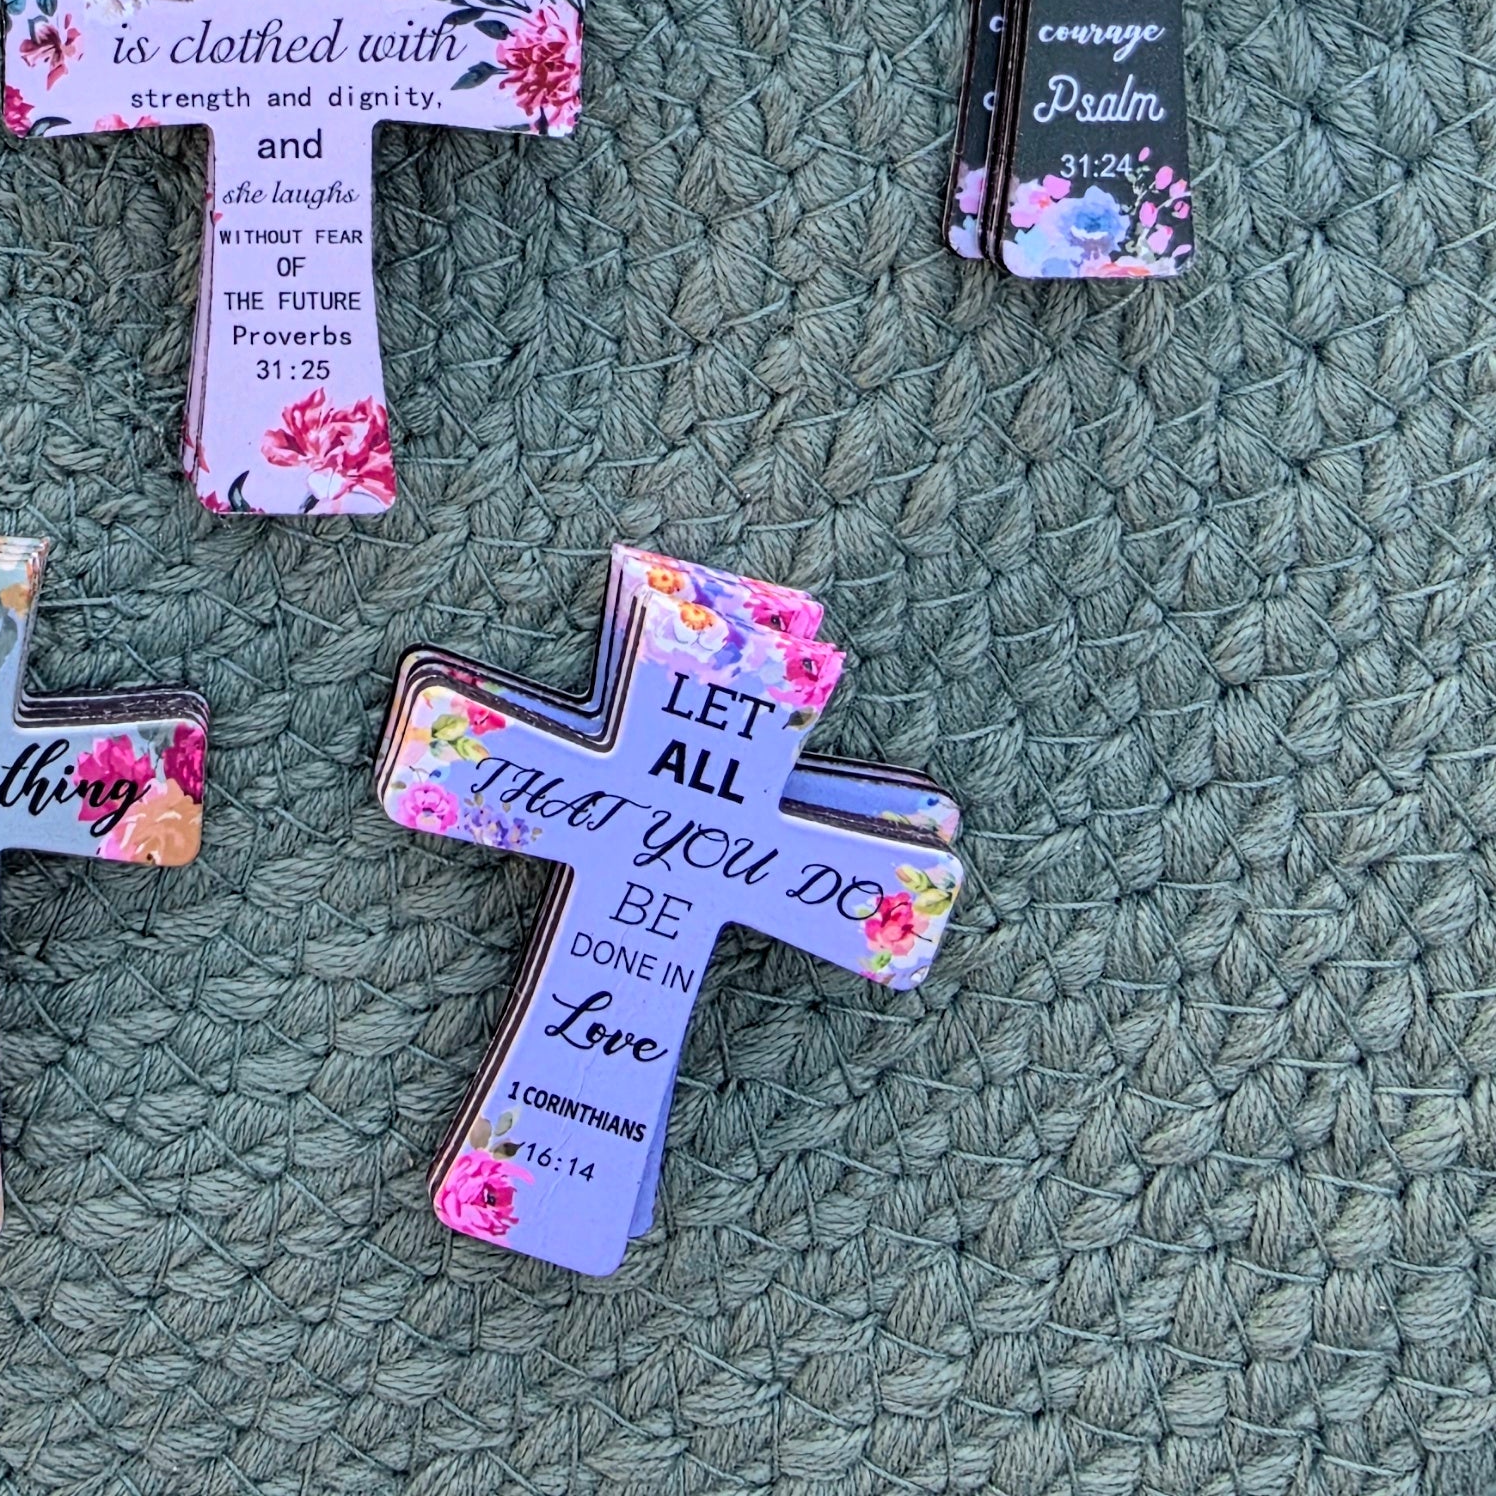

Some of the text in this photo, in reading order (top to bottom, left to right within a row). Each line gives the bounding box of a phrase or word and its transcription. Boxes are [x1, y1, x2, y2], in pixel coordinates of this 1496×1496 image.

[112, 18, 467, 65] is clothed with
[1037, 22, 1166, 63] courage
[130, 85, 443, 111] strength and dignity,
[1032, 75, 1165, 124] Psalm
[257, 129, 323, 160] and
[1060, 153, 1134, 177] 31:24
[222, 180, 360, 210] she laughs
[219, 228, 364, 245] WITHOUT FEAR
[276, 256, 306, 278] OF
[223, 291, 362, 311] THE FUTURE
[232, 325, 352, 347] Proverbs
[255, 359, 331, 381] 31:25
[661, 672, 776, 741] LET
[648, 739, 745, 805] ALL
[471, 756, 887, 922] THAT YOU DO
[609, 883, 693, 940] BE
[569, 931, 695, 994] DONE IN
[543, 990, 669, 1064] Love
[508, 1080, 648, 1144] 1 CORINTHIANS
[524, 1141, 596, 1184] 16:14
